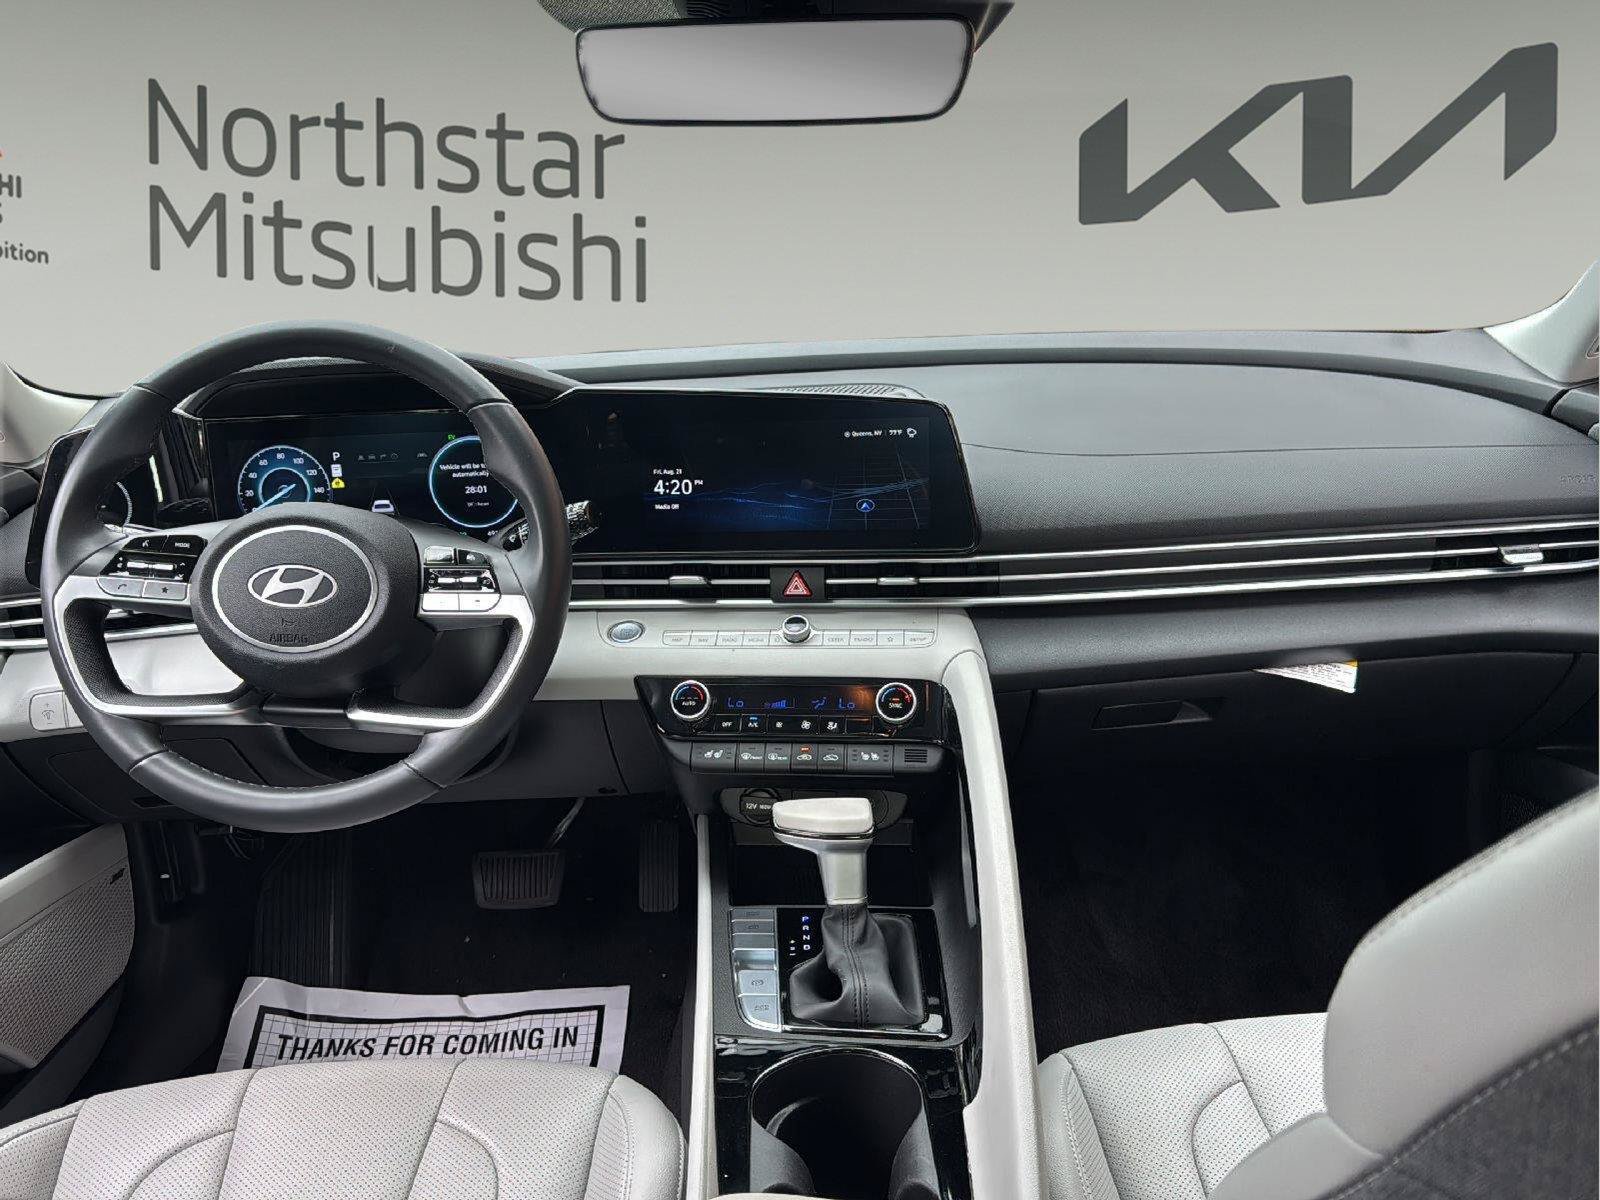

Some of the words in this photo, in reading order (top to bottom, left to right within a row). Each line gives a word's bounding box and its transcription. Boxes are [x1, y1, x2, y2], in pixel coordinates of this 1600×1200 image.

[148, 78, 624, 199] Northstar
[149, 184, 647, 303] Mitsubishi
[0, 241, 49, 264] ition
[293, 457, 304, 465] 100
[332, 452, 340, 461] P
[465, 485, 487, 494] 28:01
[653, 479, 693, 495] 4:20
[270, 633, 308, 643] AIRBAG
[746, 802, 758, 810] 12V
[276, 1033, 375, 1061] THANKS
[382, 1034, 435, 1057] FOR
[443, 1027, 544, 1056] COMING
[554, 1026, 580, 1048] IN
